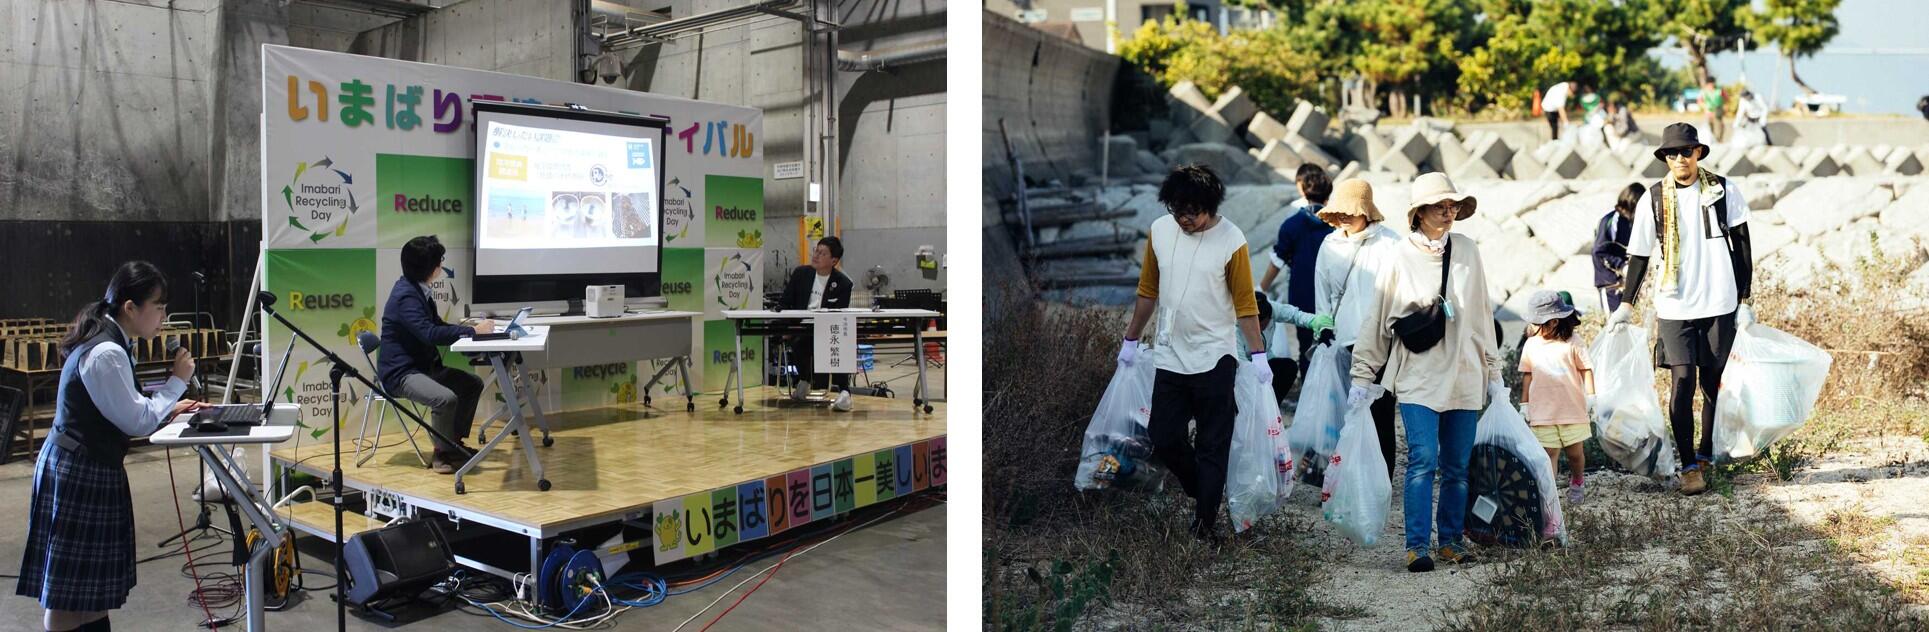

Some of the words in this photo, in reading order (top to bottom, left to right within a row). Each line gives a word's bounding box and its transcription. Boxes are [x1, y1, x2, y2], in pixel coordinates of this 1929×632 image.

[301, 183, 341, 195] Imabari
[295, 195, 347, 209] Recycling
[394, 194, 463, 213] Reduce
[664, 197, 685, 206] mabari
[311, 209, 332, 222] Day
[664, 207, 687, 218] cycling
[715, 205, 757, 221] Reduce
[666, 217, 679, 227] Day
[724, 272, 745, 280] Imabari
[662, 281, 692, 295] euse
[722, 280, 748, 290] Recycling
[728, 290, 741, 299] Day
[288, 291, 354, 311] Reuse
[713, 346, 755, 365] Reccle
[297, 392, 347, 405] Recyclg
[312, 407, 333, 418] Day
